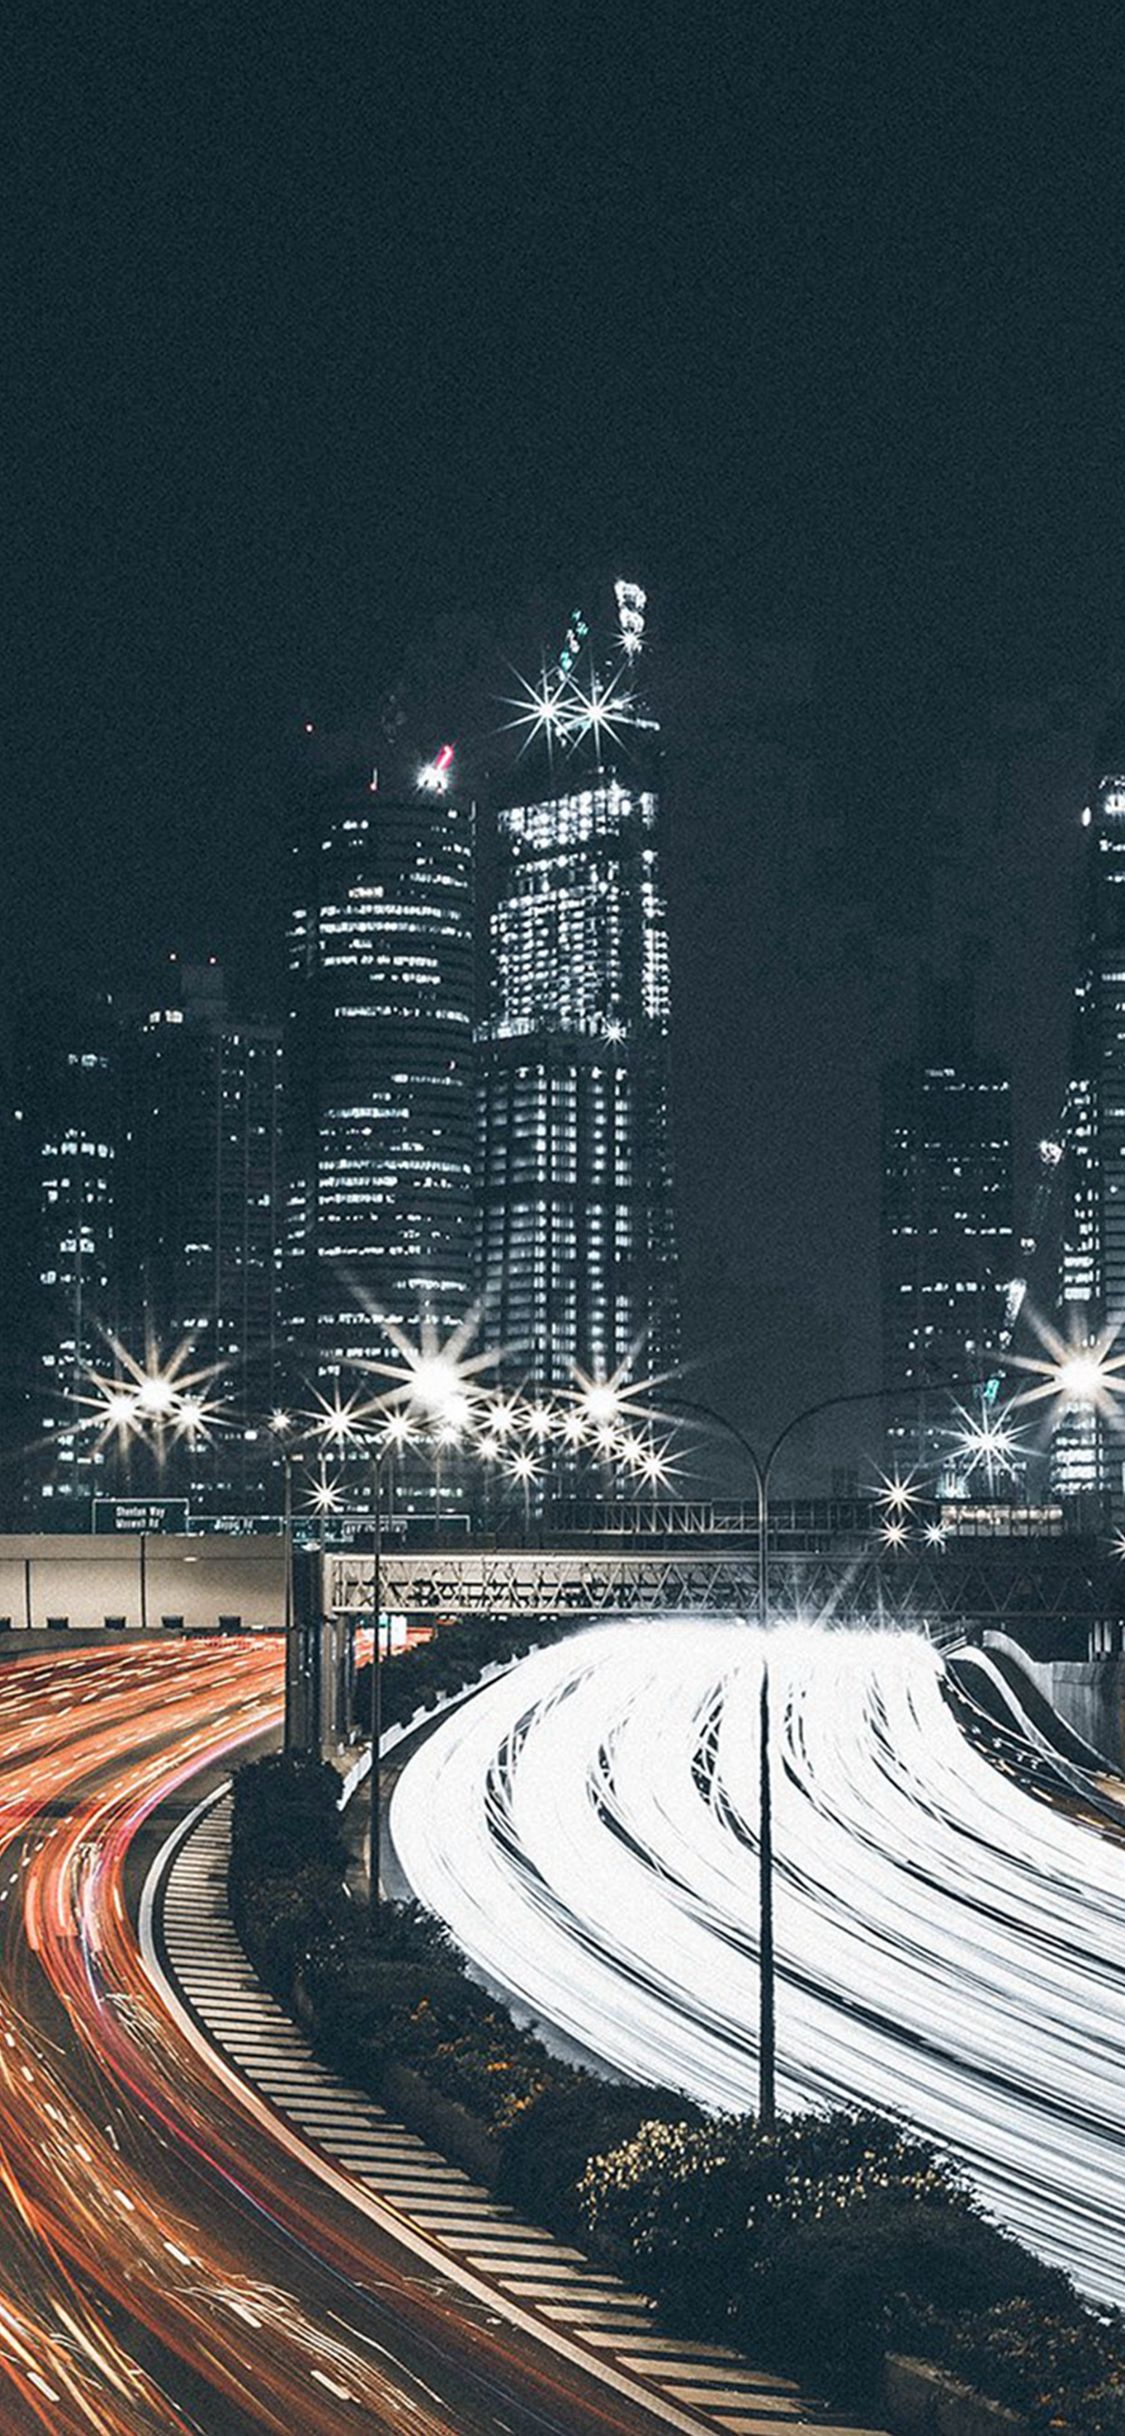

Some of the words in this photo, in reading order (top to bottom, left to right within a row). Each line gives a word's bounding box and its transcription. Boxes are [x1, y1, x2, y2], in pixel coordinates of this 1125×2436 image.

[116, 1506, 147, 1517] Shenton
[149, 1506, 165, 1519] Way
[149, 1518, 159, 1528] Rd
